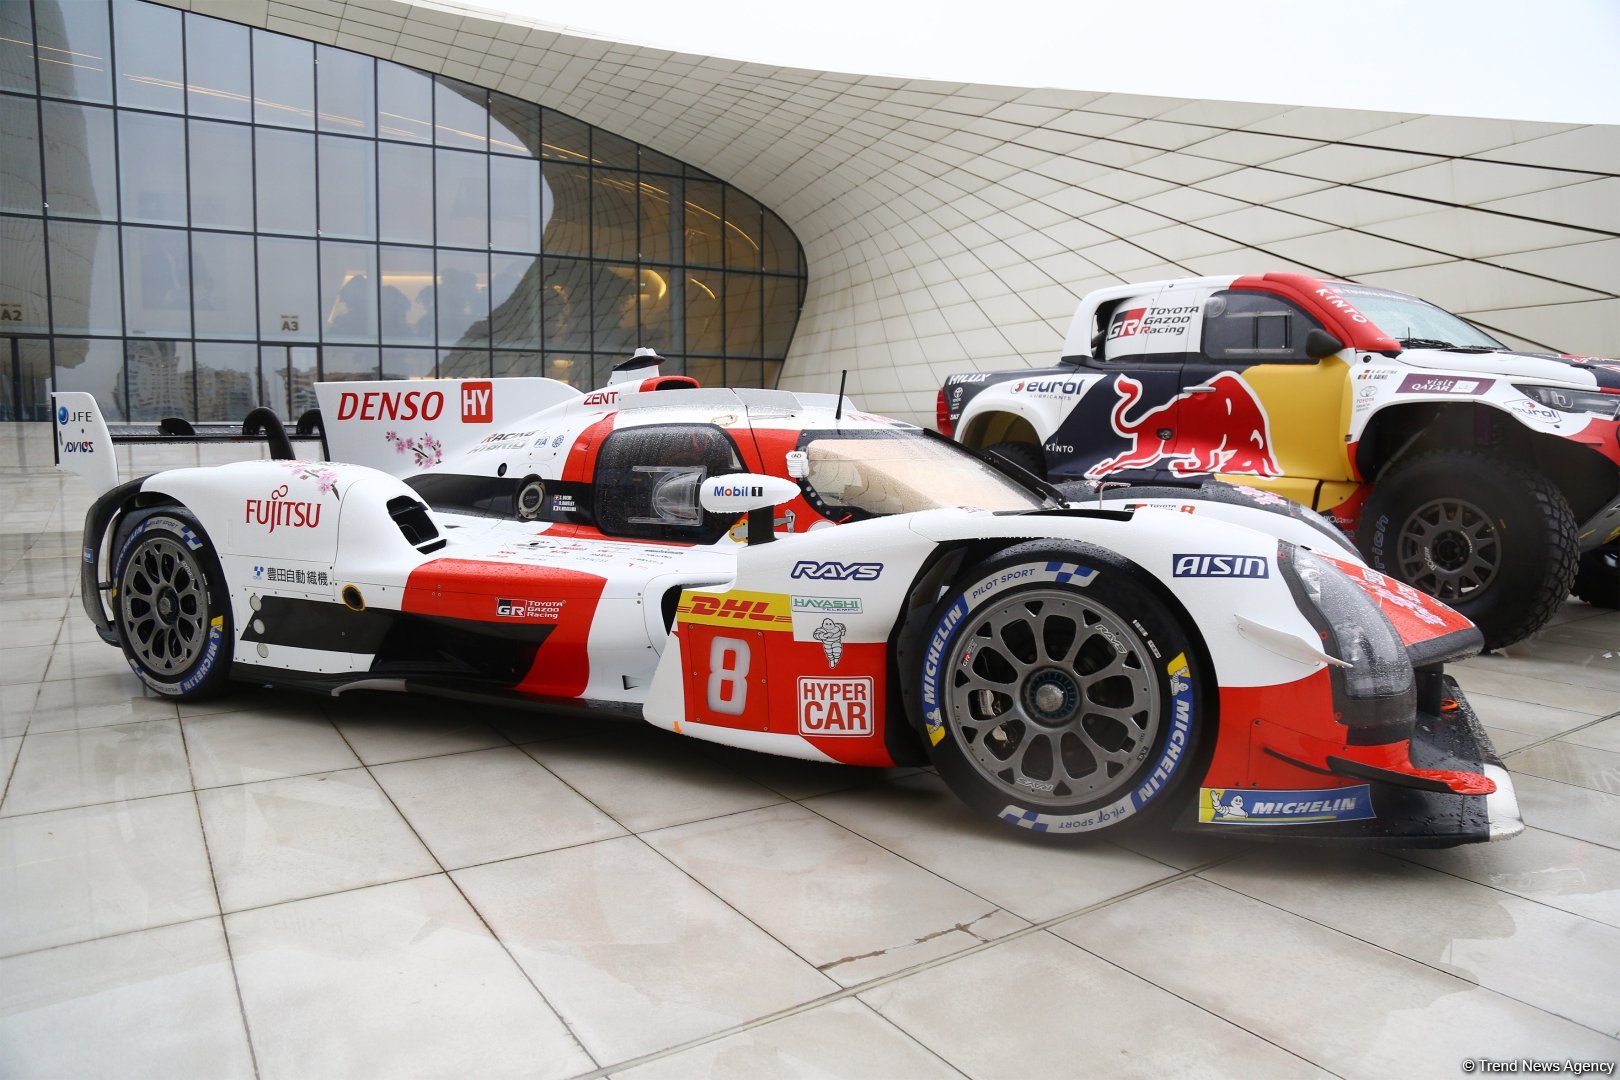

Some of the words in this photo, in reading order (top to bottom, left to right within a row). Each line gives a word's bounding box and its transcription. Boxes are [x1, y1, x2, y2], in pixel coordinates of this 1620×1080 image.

[1, 309, 23, 322] A2
[1150, 306, 1200, 315] TOYOTA
[281, 320, 299, 331] A3
[1144, 316, 1191, 325] GAZOO
[1140, 326, 1185, 336] Racing
[948, 373, 993, 386] HILUX
[1026, 379, 1086, 395] eurol
[1411, 383, 1450, 392] QATAR
[1427, 378, 1454, 386] visit
[337, 391, 444, 421] DENSO
[462, 389, 490, 416] HY
[583, 391, 619, 405] ZENT
[70, 411, 93, 423] JFE
[713, 485, 748, 498] Mobil
[751, 486, 763, 497] 1
[245, 484, 321, 533] FUJITSU
[791, 561, 883, 581] RAYS
[1176, 556, 1264, 577] AISIN
[972, 579, 999, 599] PILOT
[1000, 568, 1036, 583] SPORT
[498, 605, 525, 616] GR
[690, 595, 777, 621] DHL
[793, 598, 860, 609] HAYASHI
[1095, 624, 1128, 654] RAYS
[924, 605, 963, 705] MICHELIN
[183, 642, 218, 691] MICHELIN
[707, 636, 750, 715] 8
[803, 683, 867, 700] HYPER
[804, 701, 867, 731] CAR
[1138, 700, 1190, 803] MICHELIN
[1252, 797, 1357, 815] MICHELIN
[1058, 817, 1095, 830] SPORT
[1096, 806, 1126, 825] PILOT
